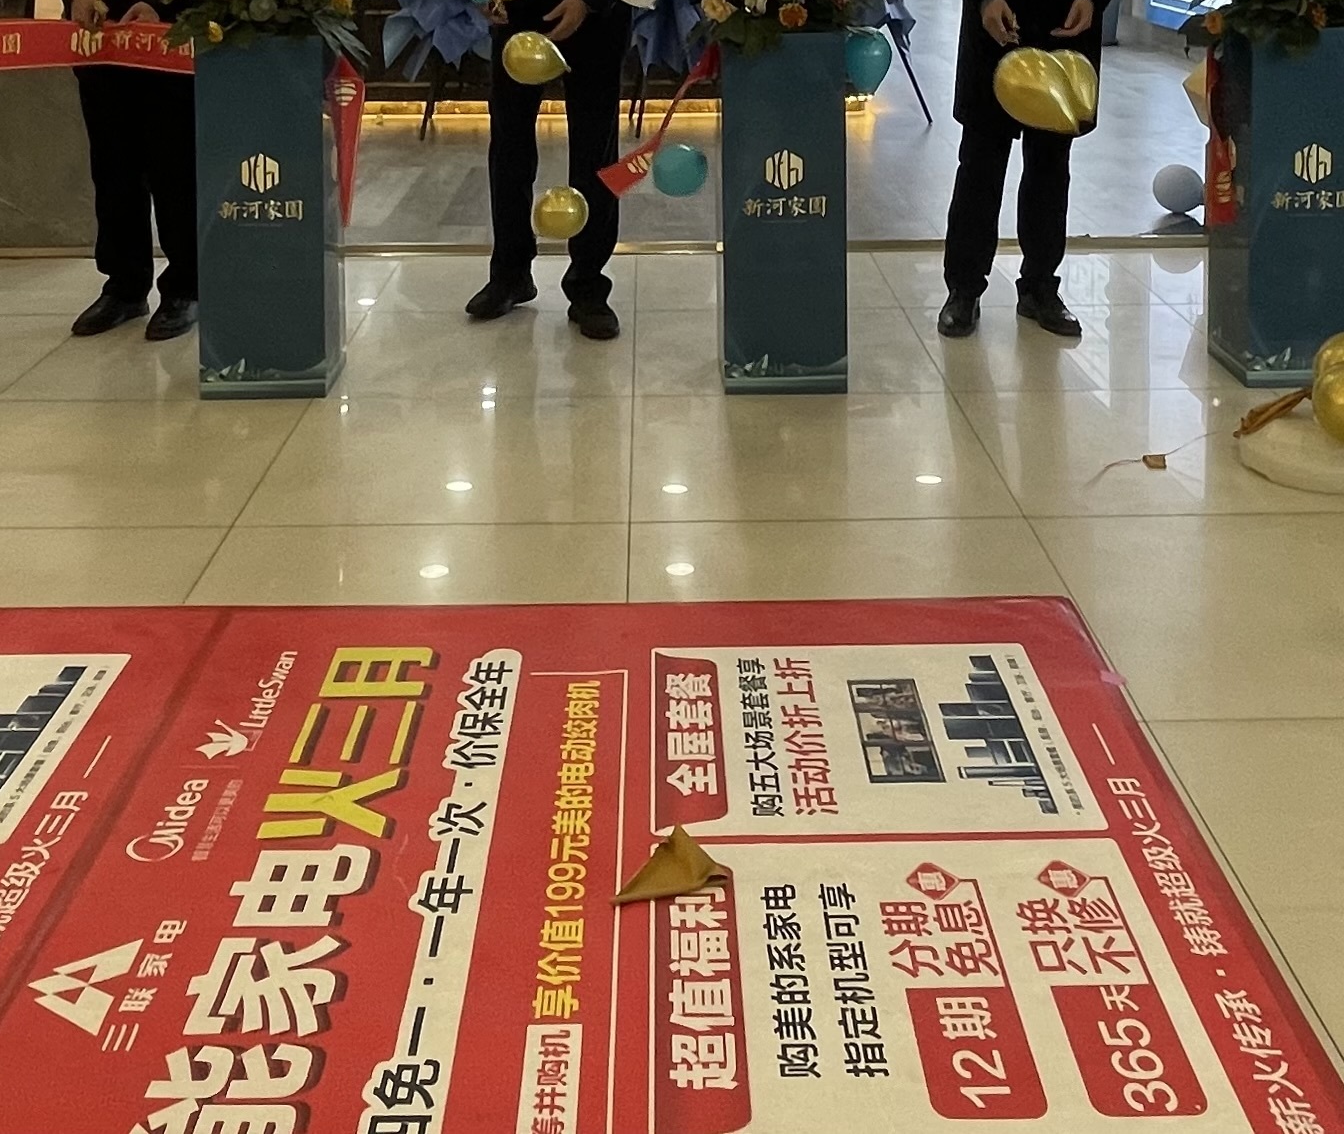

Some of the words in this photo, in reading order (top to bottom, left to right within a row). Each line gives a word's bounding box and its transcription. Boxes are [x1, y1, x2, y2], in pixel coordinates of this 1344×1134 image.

[216, 198, 305, 222] 新河家園
[741, 195, 827, 219] 新河家園
[246, 649, 299, 733] LittleSwan
[665, 673, 718, 797] 全屋套餐
[736, 657, 785, 817] 购五大场景套餐享
[773, 657, 839, 816] 活动价折上折
[125, 778, 209, 863] Midea
[760, 883, 822, 1079] 购美的系家电
[818, 882, 890, 1078] 指定机型可享
[879, 901, 945, 978] 分期
[932, 899, 1000, 978] 免息
[1016, 897, 1088, 975] 只换
[1067, 897, 1138, 974] 不修
[100, 918, 188, 1053] 三联家电
[935, 996, 1012, 1109] 12期
[1097, 985, 1180, 1113] 365天
